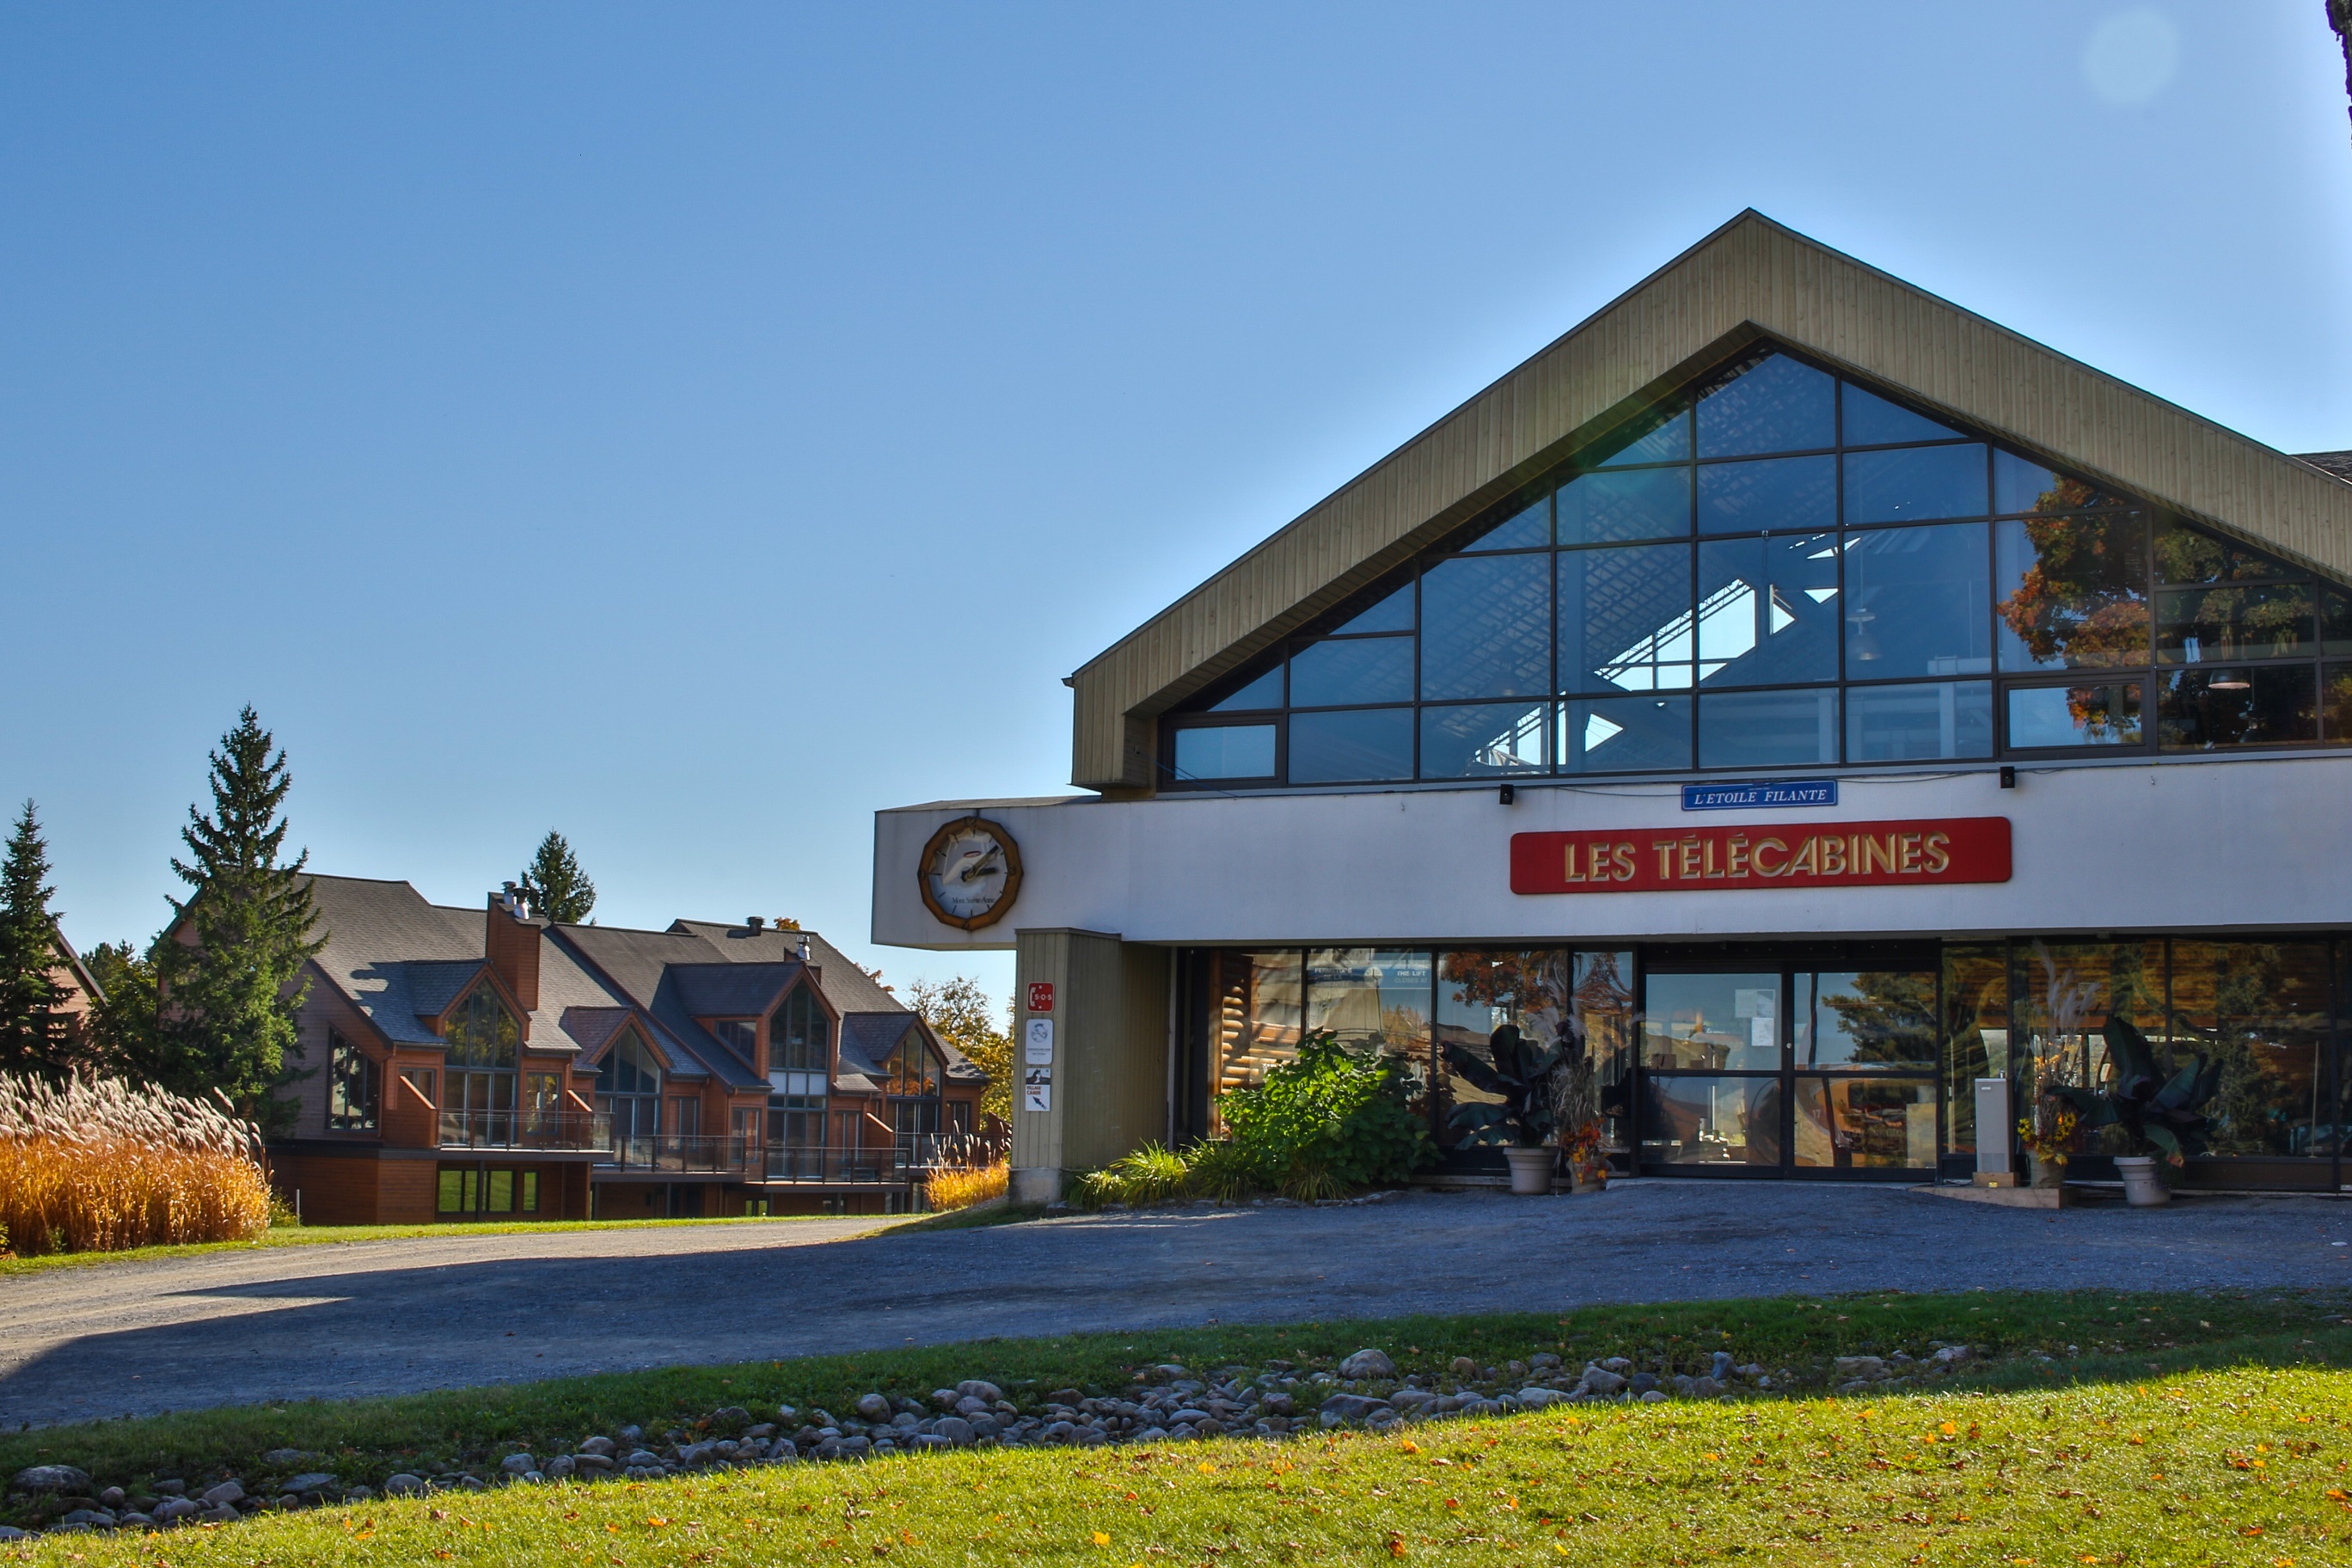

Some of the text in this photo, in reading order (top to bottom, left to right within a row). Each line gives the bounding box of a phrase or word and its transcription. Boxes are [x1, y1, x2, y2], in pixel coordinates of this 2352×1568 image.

[1694, 788, 1827, 805] L'ETOILE FILANTE
[1564, 831, 1951, 883] LES TÉLÉCABINES
